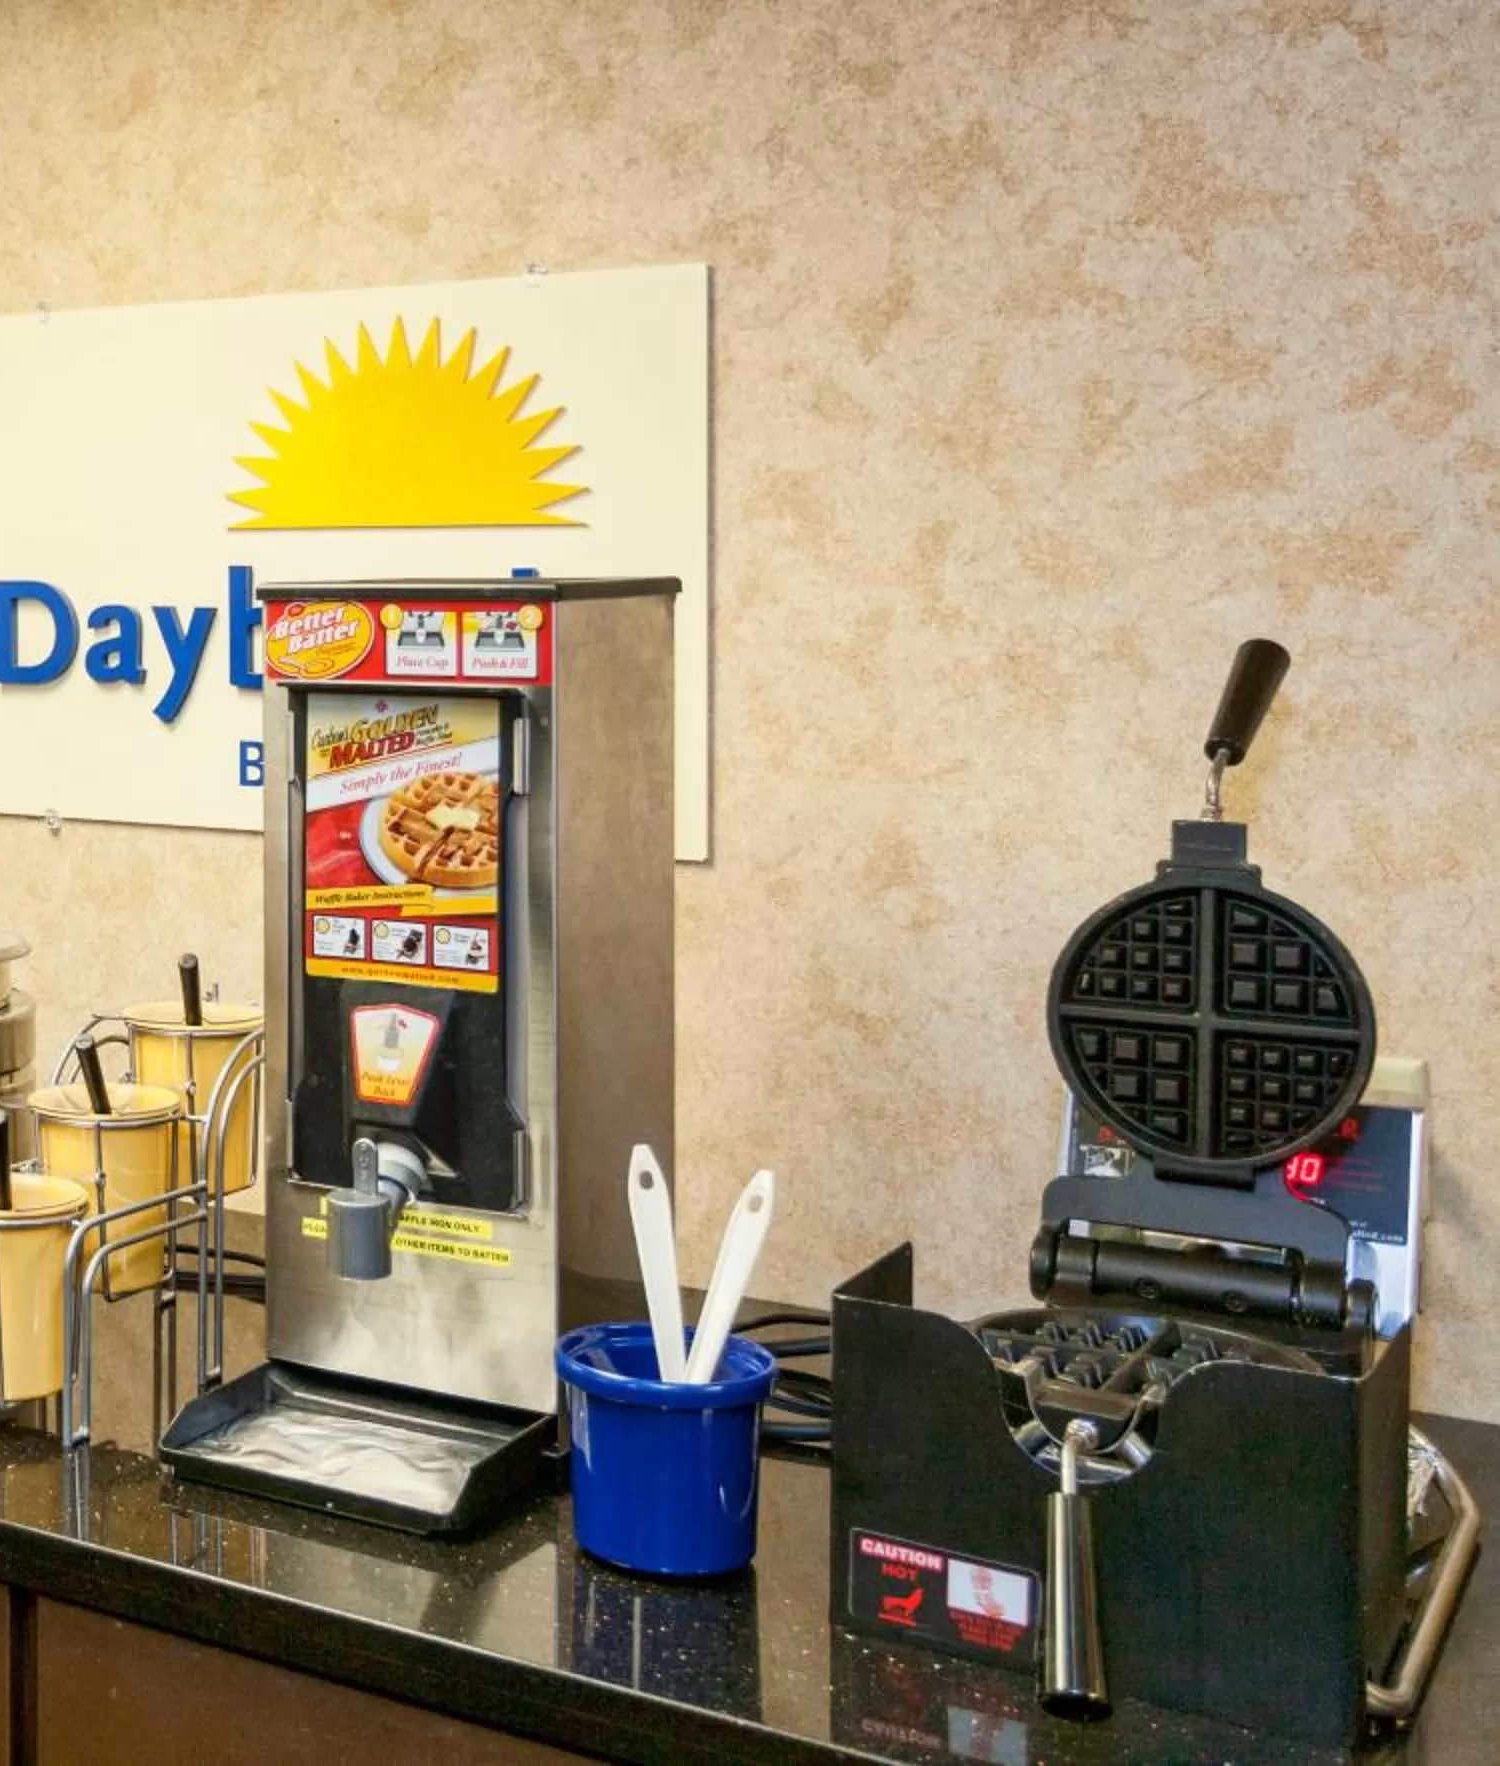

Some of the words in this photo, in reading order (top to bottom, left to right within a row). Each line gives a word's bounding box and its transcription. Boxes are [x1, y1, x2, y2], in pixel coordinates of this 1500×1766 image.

[275, 606, 345, 639] Better
[288, 620, 358, 653] Batter
[426, 656, 449, 670] Cup
[330, 732, 415, 768] MALTED
[340, 771, 386, 794] Simply
[390, 766, 412, 782] the
[399, 1213, 426, 1227] AFFLE
[453, 1221, 481, 1234] ONLY
[428, 1241, 456, 1255] ITEMS
[860, 1537, 944, 1571] CAUTION
[881, 1563, 919, 1582] HOT
